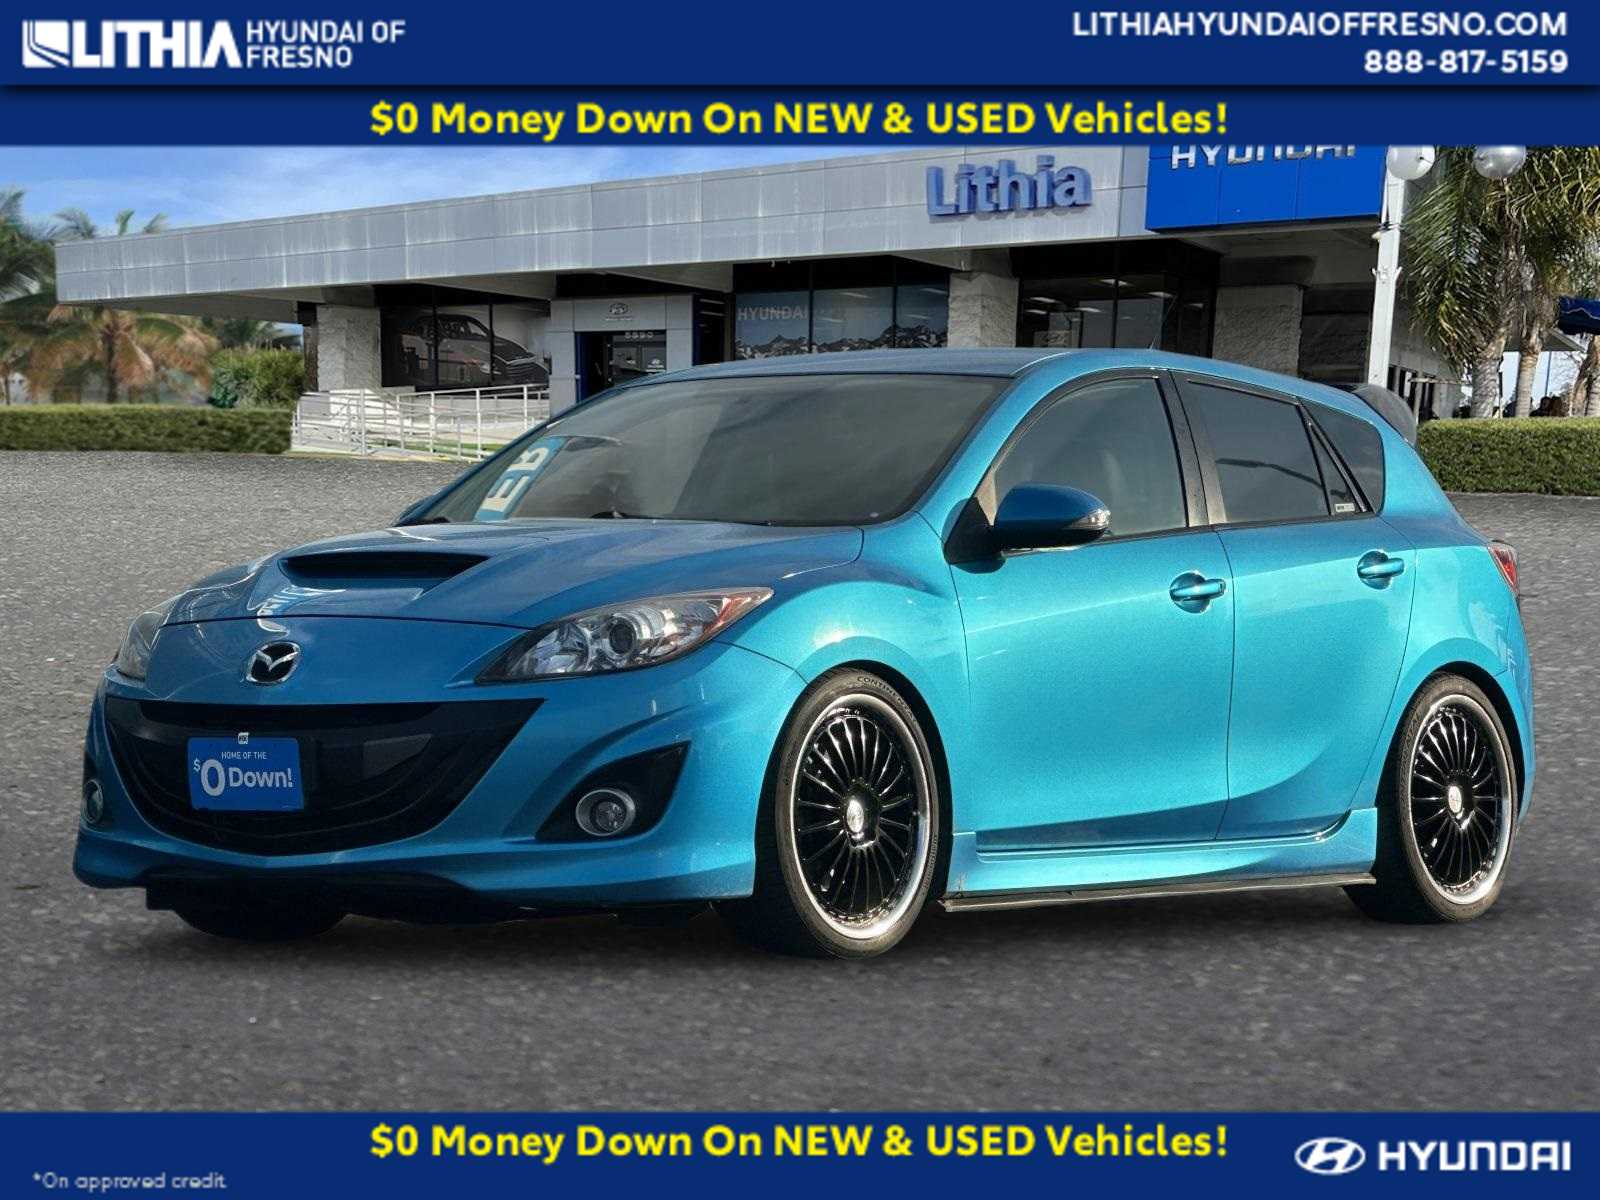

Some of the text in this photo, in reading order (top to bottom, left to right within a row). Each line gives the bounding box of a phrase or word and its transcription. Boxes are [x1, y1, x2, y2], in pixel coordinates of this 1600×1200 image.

[926, 155, 1092, 215] Lithia
[737, 306, 809, 321] HYUNDAI
[221, 752, 267, 760] HOME OF THE
[229, 767, 293, 788] Down!
